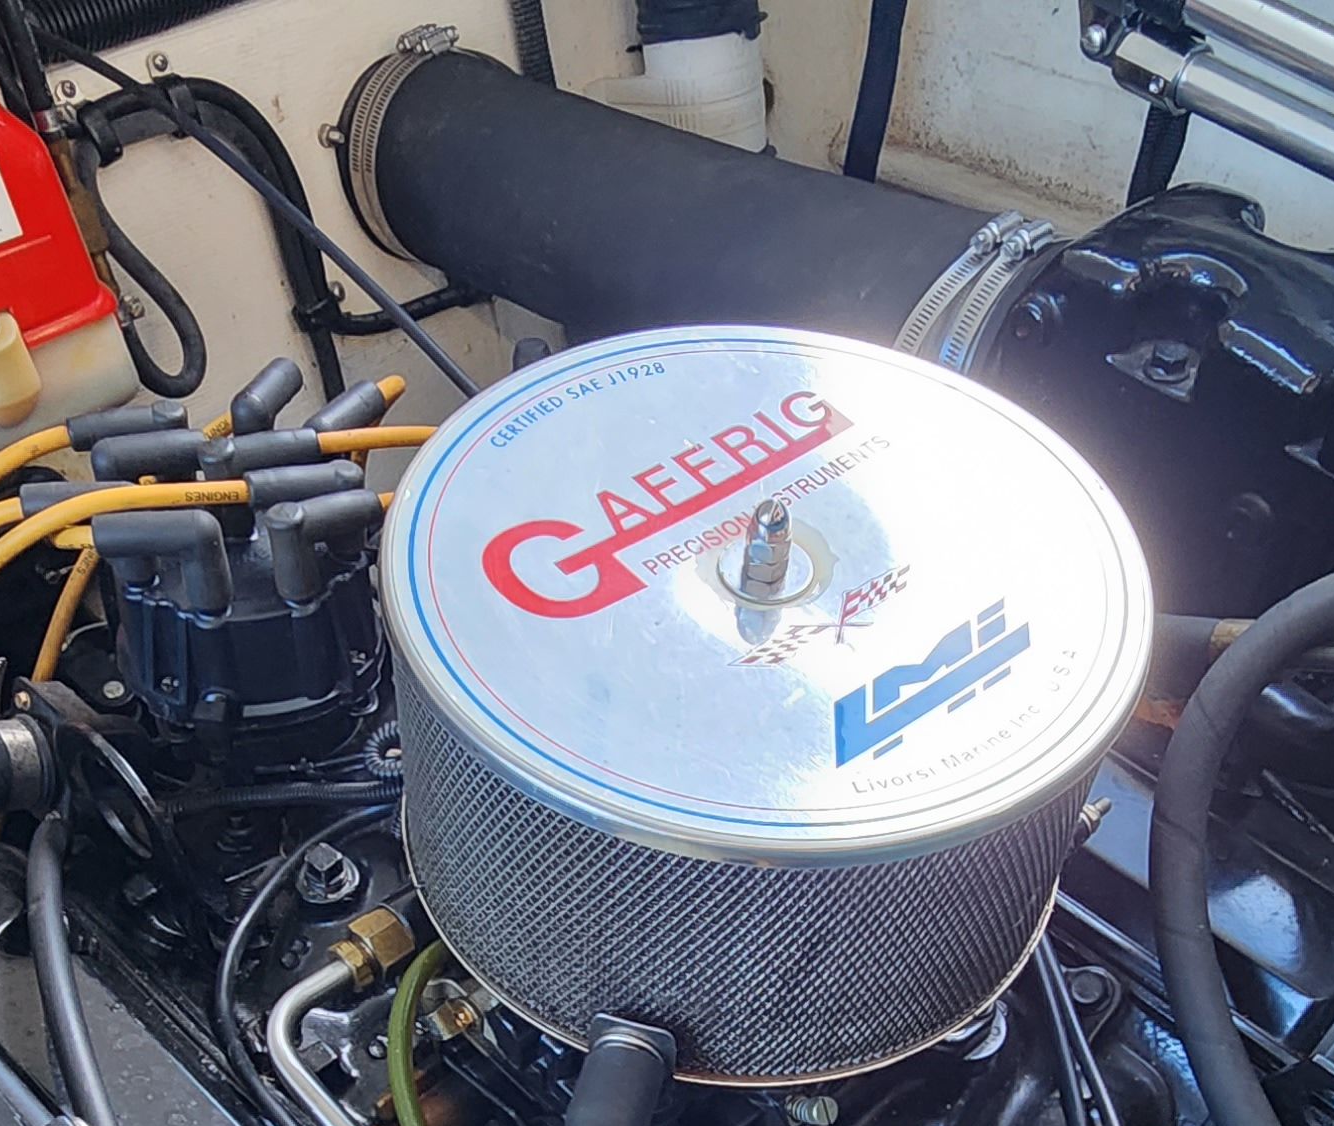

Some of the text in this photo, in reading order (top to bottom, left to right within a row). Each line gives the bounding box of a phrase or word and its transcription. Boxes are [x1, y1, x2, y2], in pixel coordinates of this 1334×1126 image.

[486, 359, 667, 450] CERTIFIED SAE J1928
[185, 492, 239, 501] ENGINES
[480, 389, 855, 620] GAFFRIG
[642, 511, 754, 575] PRECISION
[852, 766, 936, 794] Livorsi
[941, 729, 1012, 769] Marine
